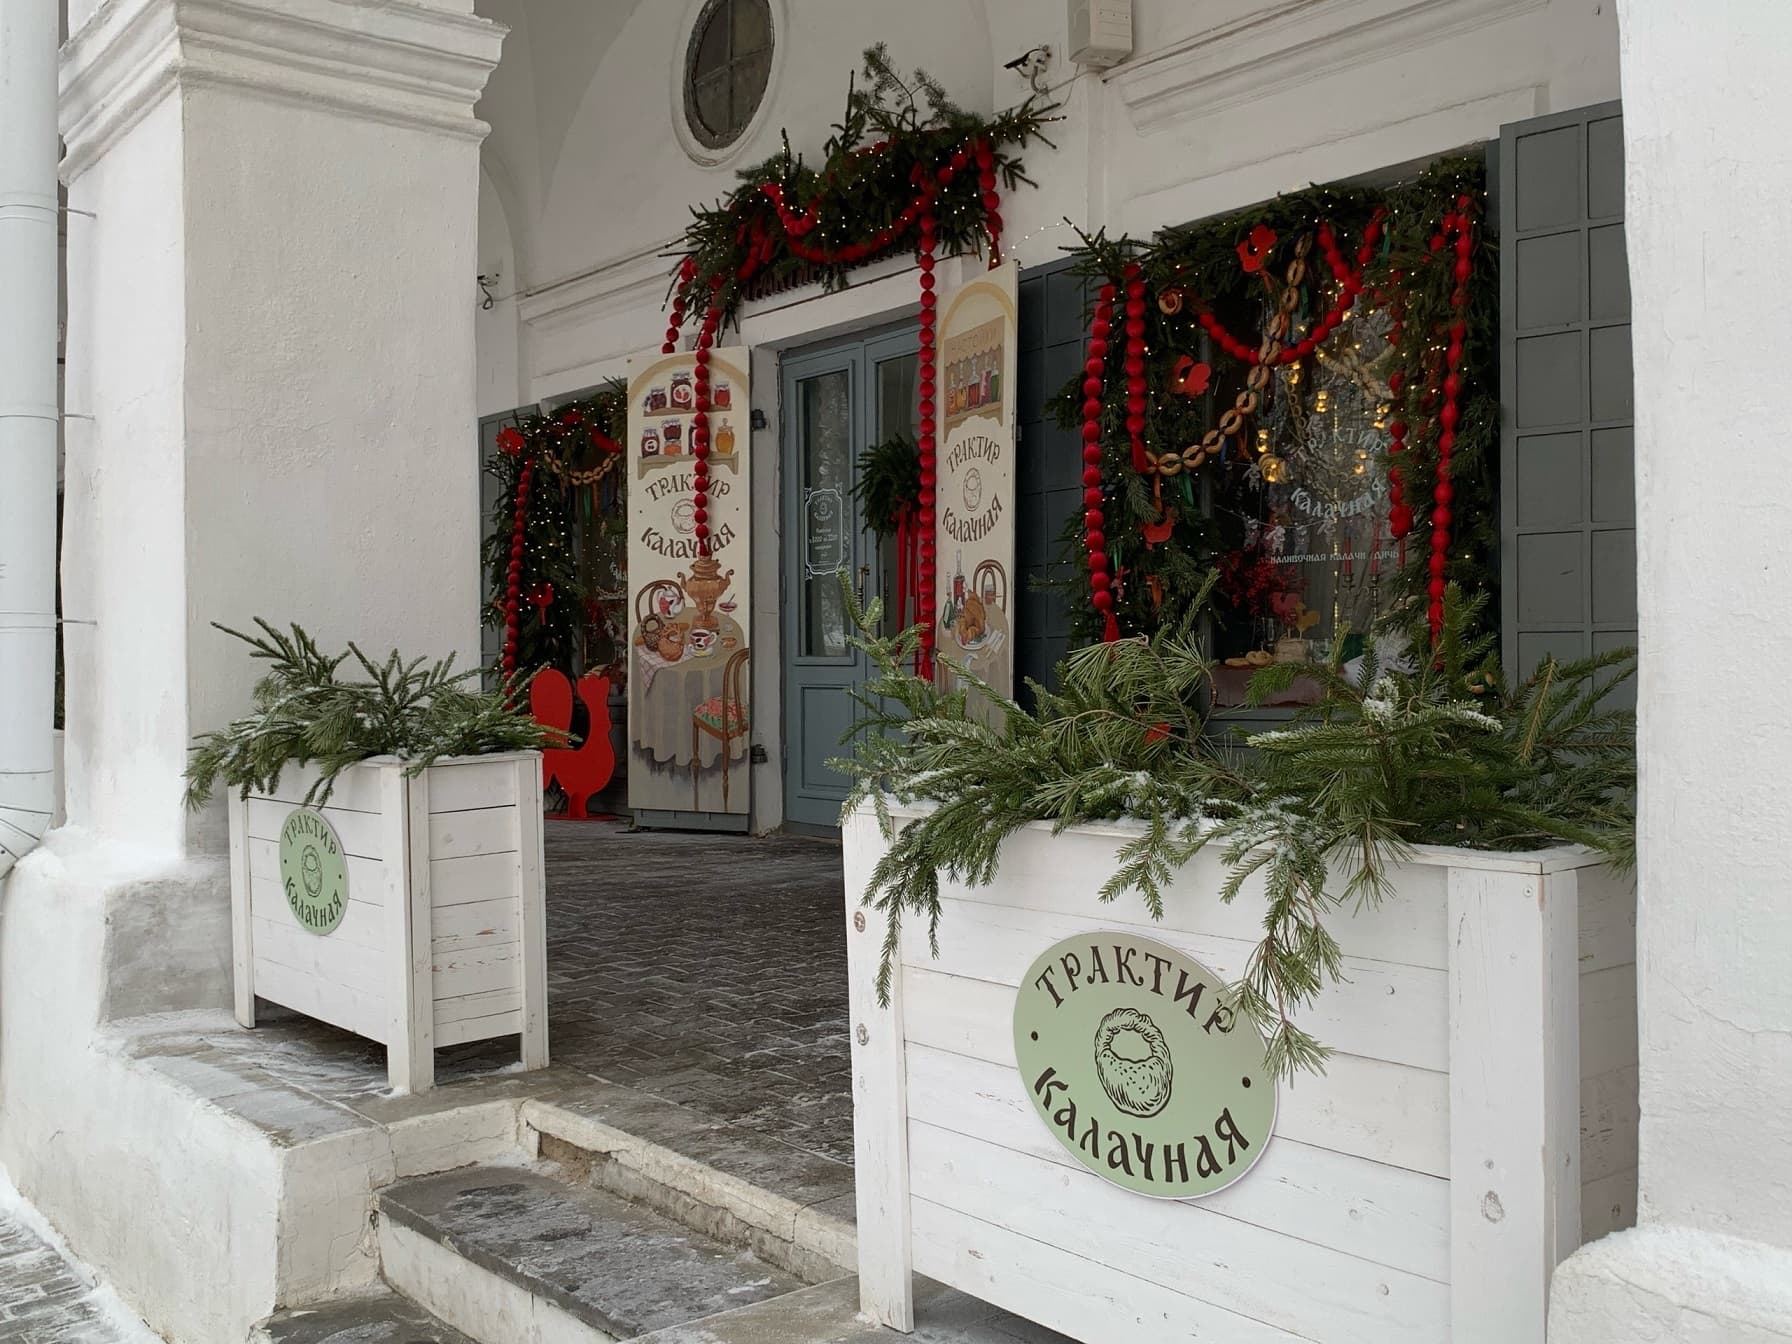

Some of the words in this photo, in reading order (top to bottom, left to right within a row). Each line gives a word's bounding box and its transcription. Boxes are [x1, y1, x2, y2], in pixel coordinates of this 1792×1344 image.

[946, 435, 1001, 473] ТРАКТИР
[645, 473, 731, 502] ТРАКИР
[284, 814, 337, 855] ТРАКТИР
[1034, 945, 1235, 1035] ТРАКТИР
[1034, 1066, 1250, 1184] Калачная
